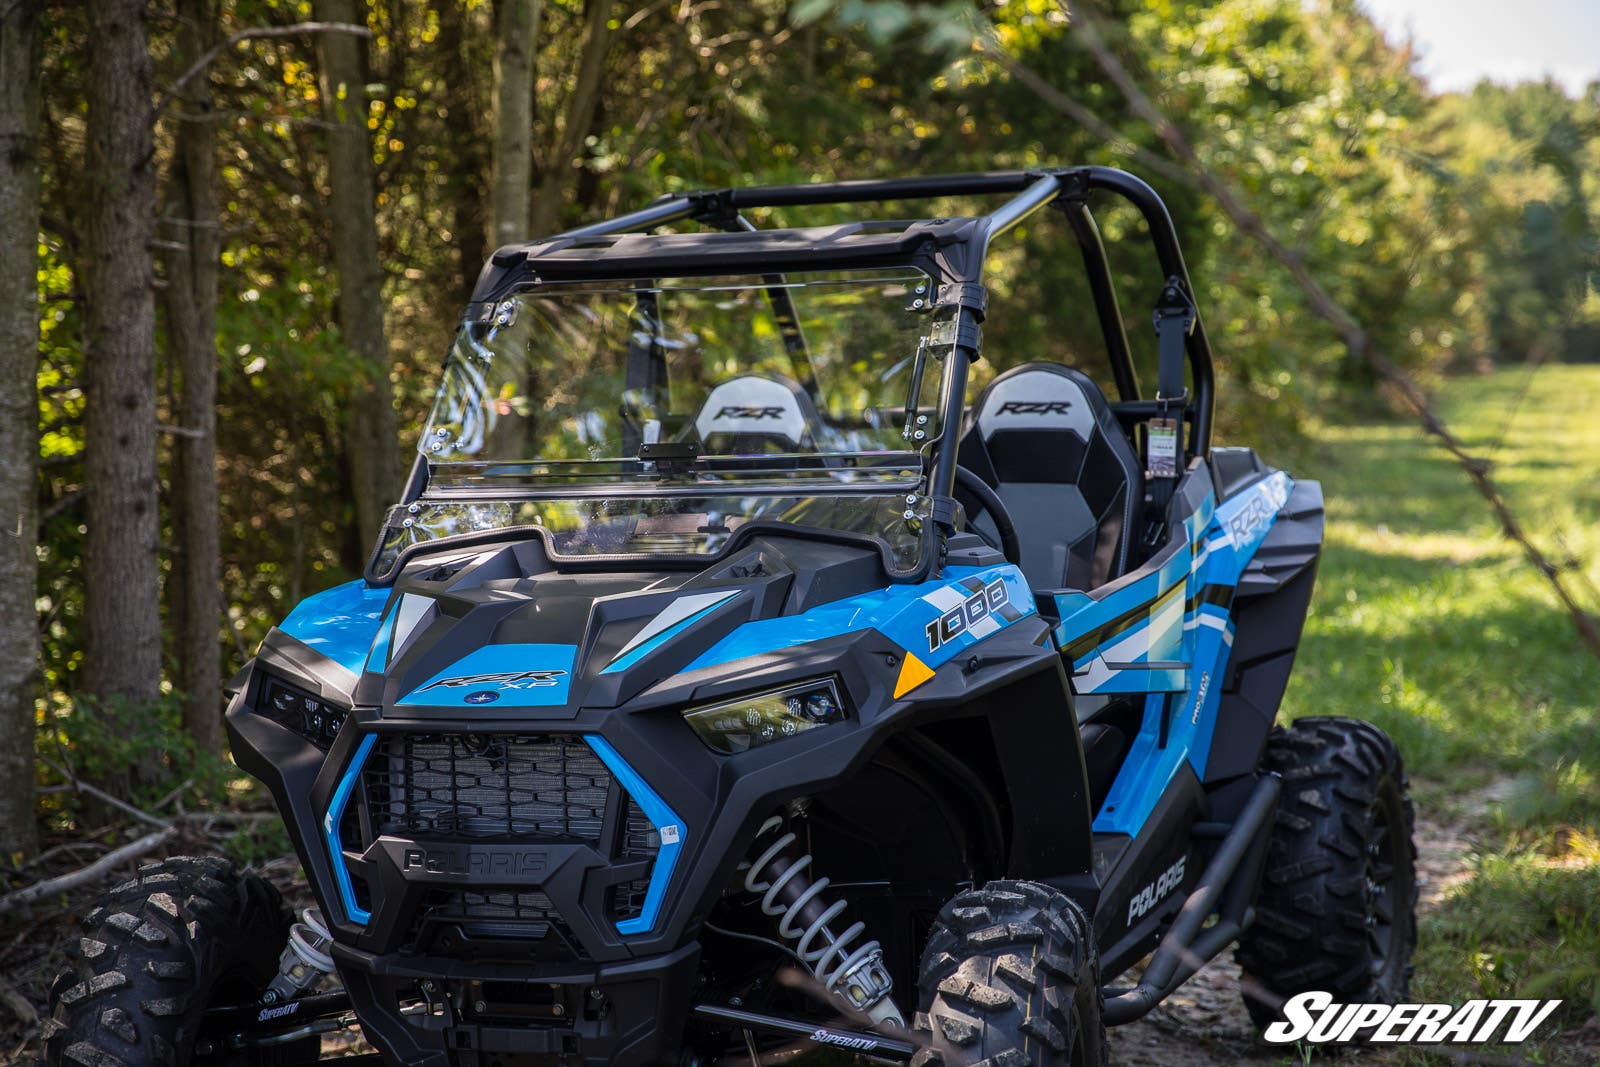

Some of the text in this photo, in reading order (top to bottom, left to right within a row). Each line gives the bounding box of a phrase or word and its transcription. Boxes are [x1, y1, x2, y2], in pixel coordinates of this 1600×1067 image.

[713, 406, 786, 420] RZR
[995, 401, 1072, 416] RZR
[1228, 496, 1273, 551] RZR
[925, 577, 1009, 653] 1000
[413, 670, 568, 694] RZR
[499, 681, 558, 690] XP
[403, 849, 548, 876] POLARIS
[1126, 855, 1187, 927] POLARIS
[258, 1002, 299, 1021] SUPERATV
[810, 1029, 878, 1050] SUPERATV
